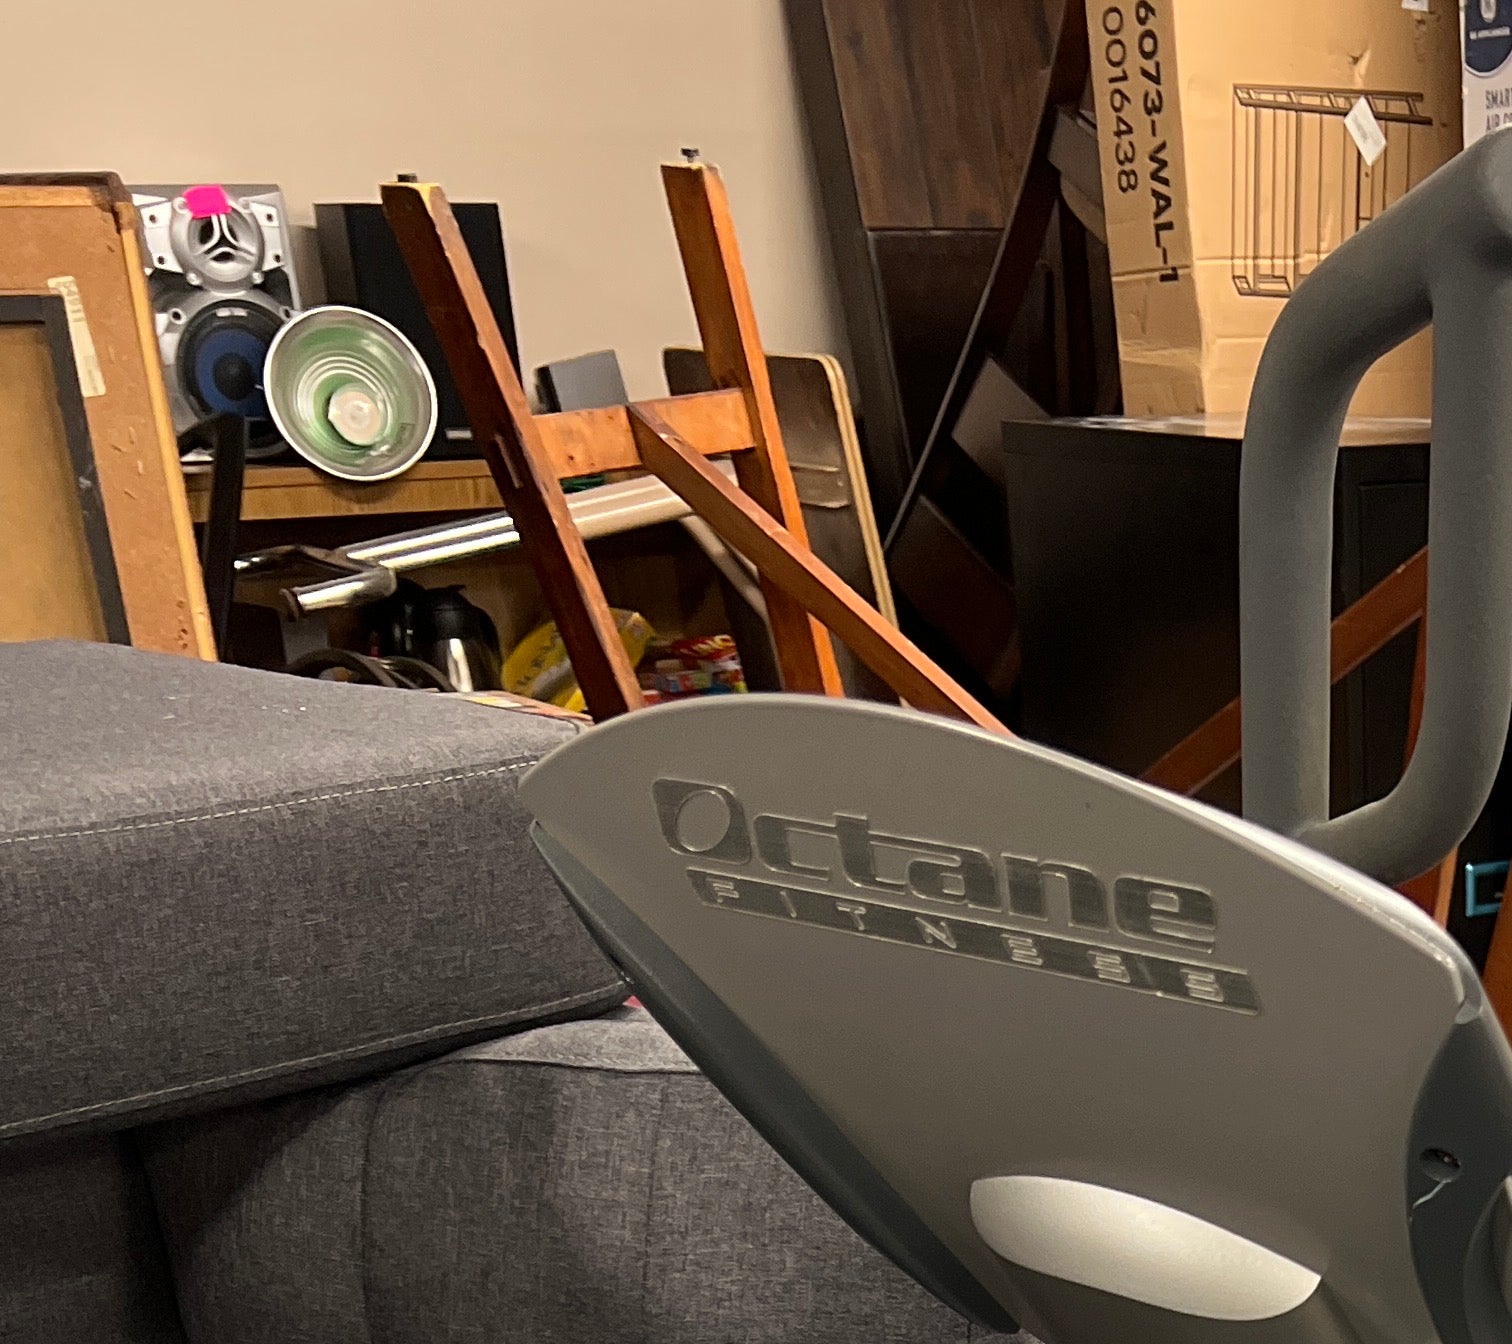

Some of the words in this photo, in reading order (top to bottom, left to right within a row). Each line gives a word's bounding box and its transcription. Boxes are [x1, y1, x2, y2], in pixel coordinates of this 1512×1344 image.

[1103, 6, 1138, 194] 0016438
[653, 778, 1218, 953] Octane
[705, 876, 1225, 1003] FITNESS
